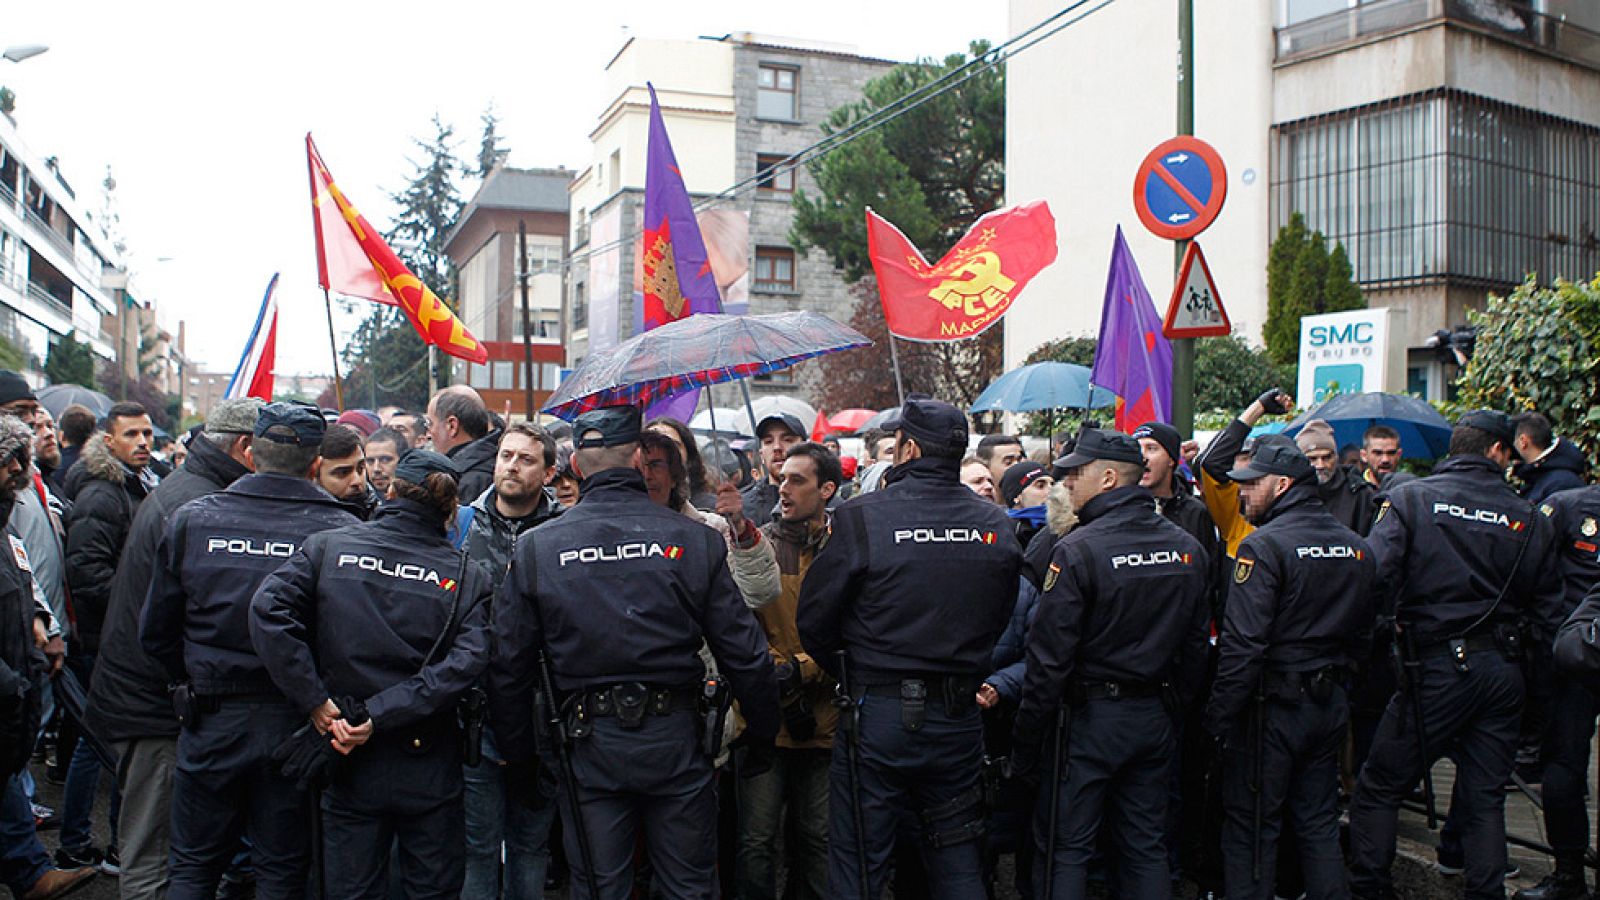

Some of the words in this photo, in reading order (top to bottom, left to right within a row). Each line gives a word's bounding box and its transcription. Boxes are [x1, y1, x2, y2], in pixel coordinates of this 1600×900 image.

[941, 286, 1007, 316] PCE
[1309, 322, 1374, 347] SMC
[1307, 346, 1373, 360] GRUPO
[1433, 502, 1510, 527] POLICIA
[894, 528, 984, 544] POLICIA
[208, 538, 303, 557] POLICI
[559, 543, 666, 566] POLICIA
[1296, 546, 1356, 560] POLICIA
[337, 553, 441, 586] POLICIA
[1111, 550, 1183, 569] POLICIA
